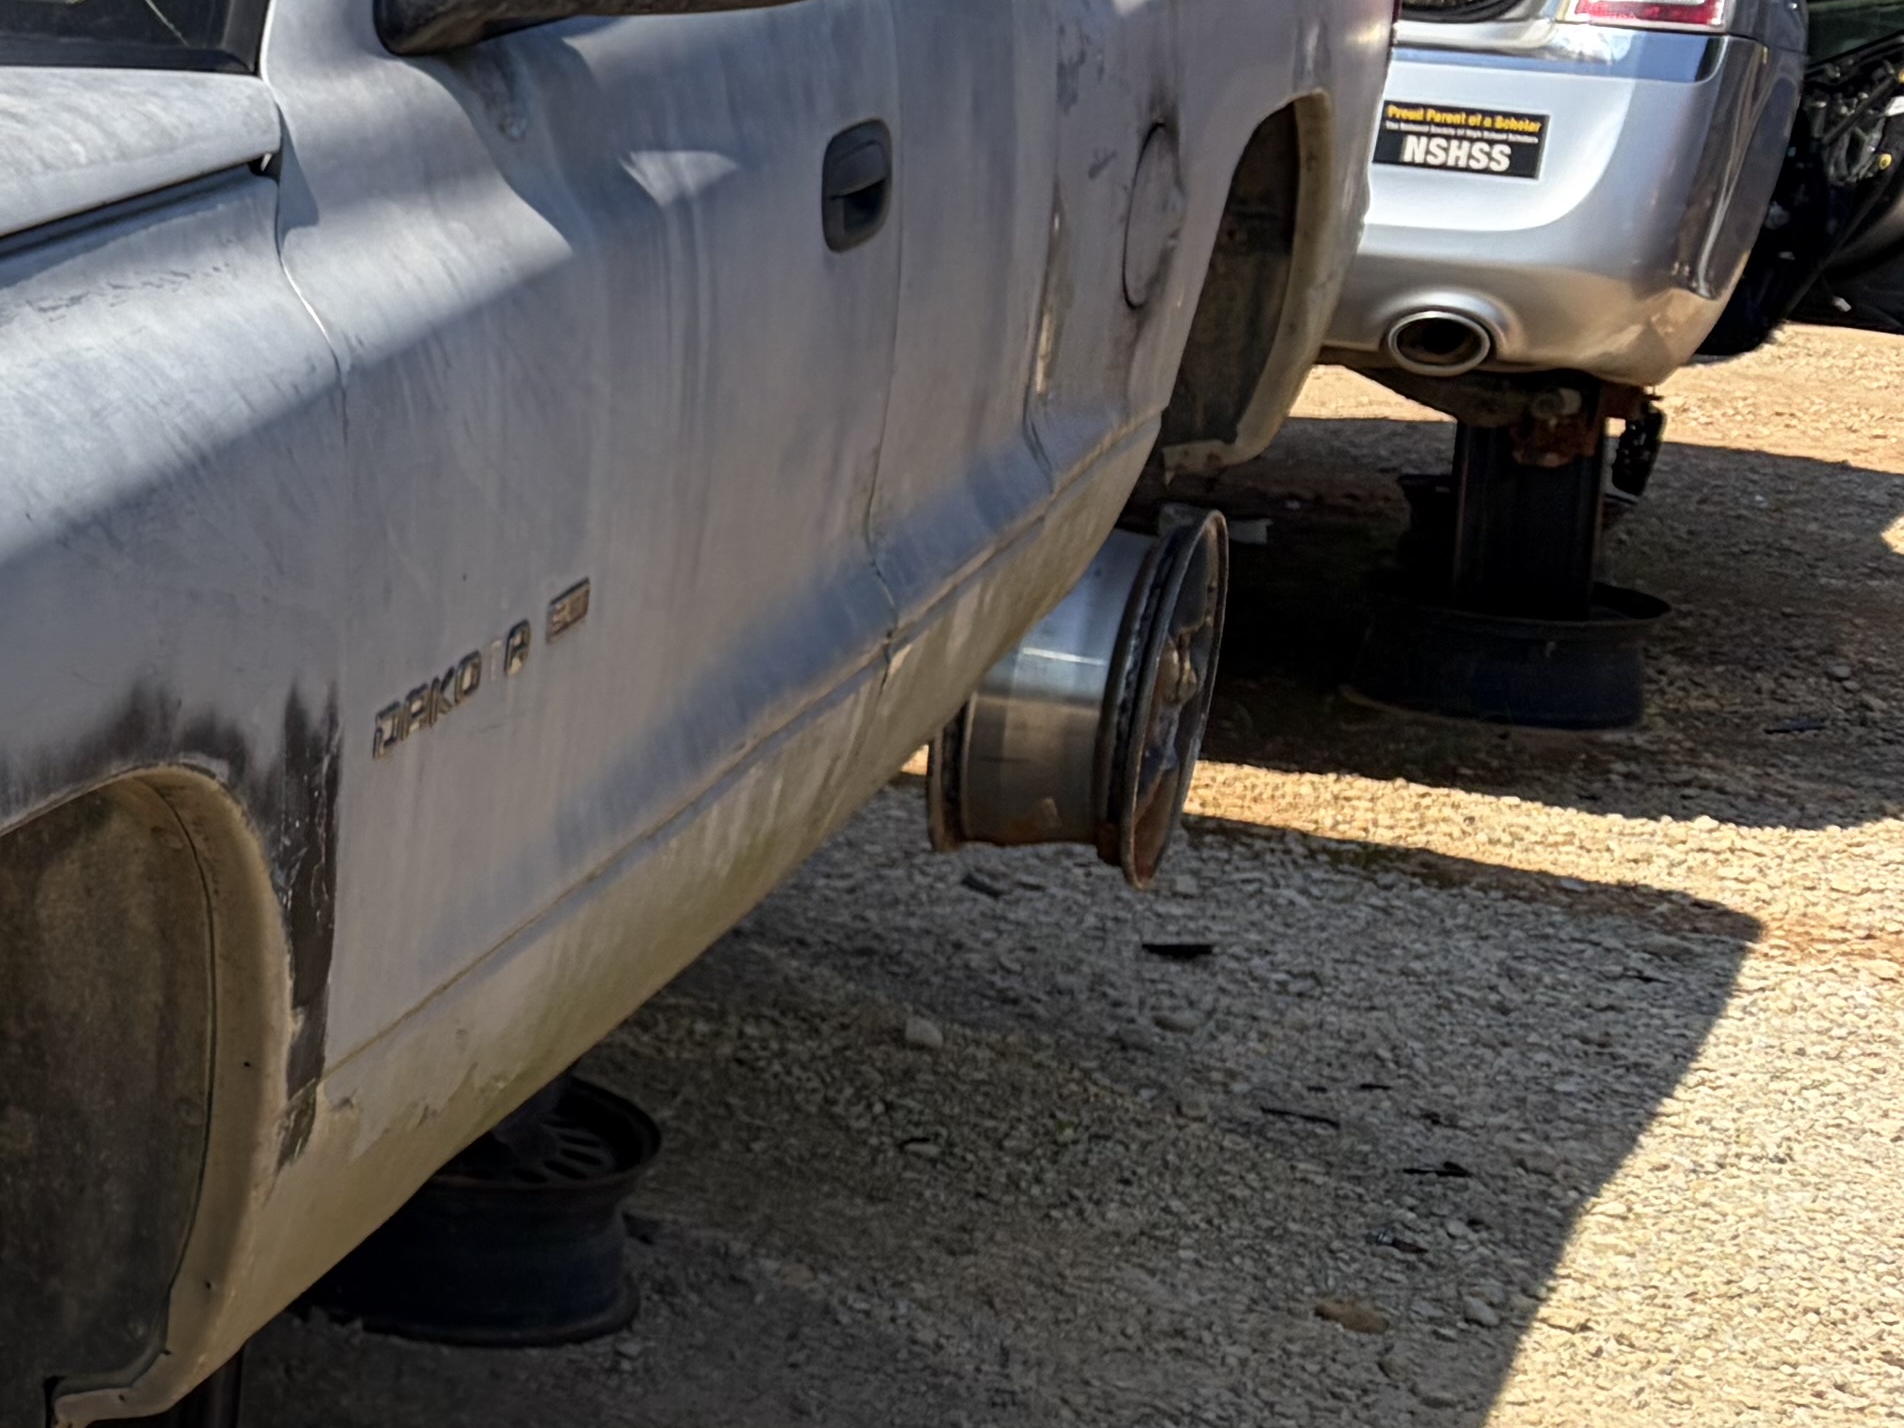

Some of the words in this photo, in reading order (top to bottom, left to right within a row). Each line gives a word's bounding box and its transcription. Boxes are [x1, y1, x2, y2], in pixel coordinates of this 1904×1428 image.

[1386, 104, 1424, 121] Proud
[1426, 108, 1467, 125] Parent
[1403, 135, 1512, 173] NSHSS
